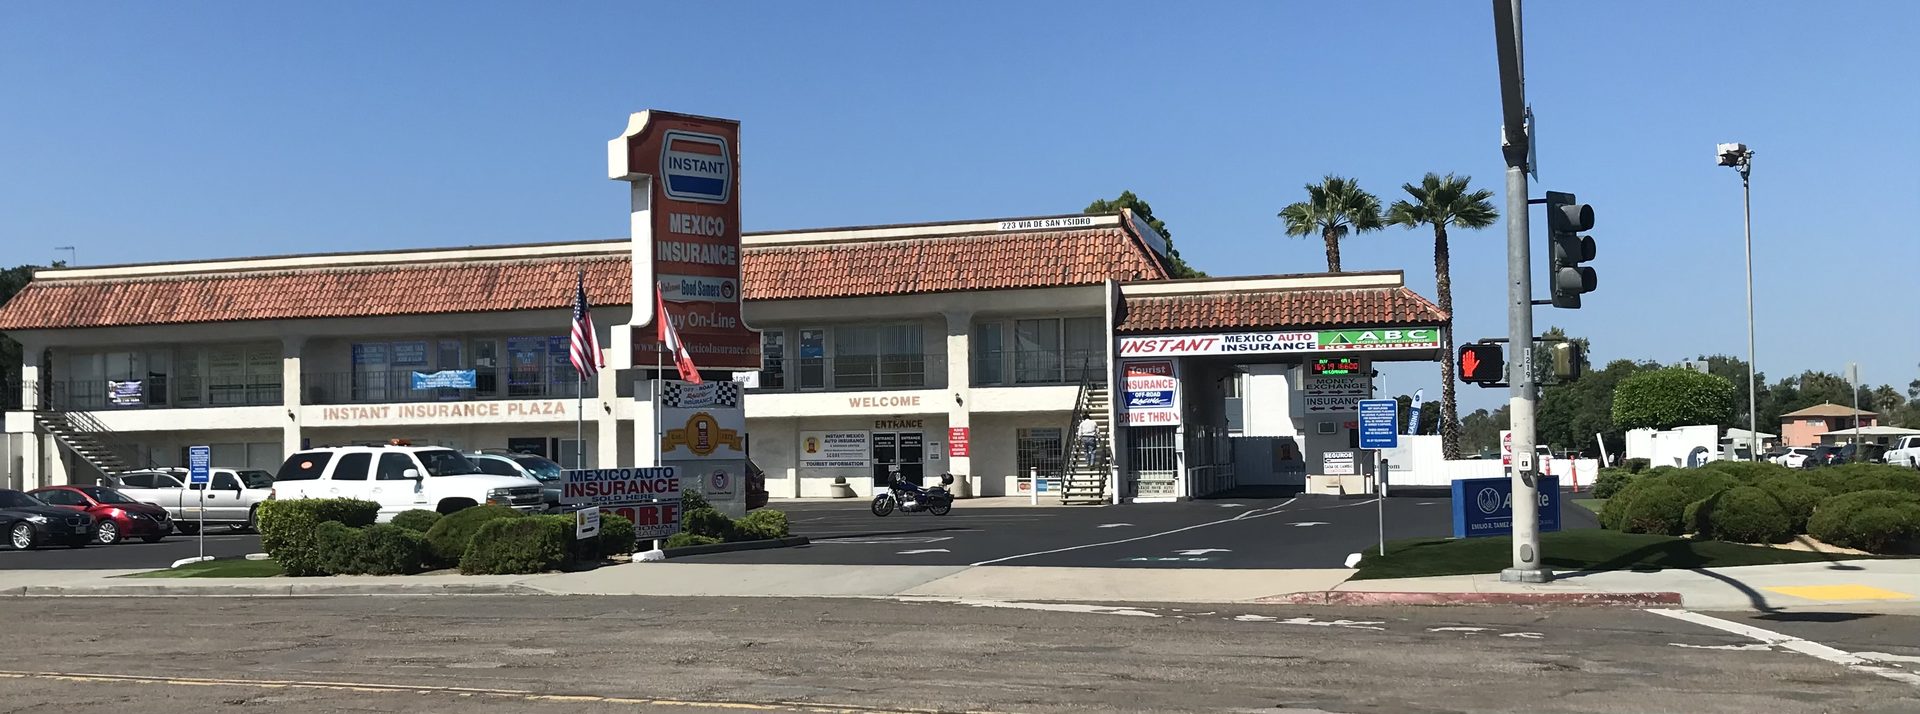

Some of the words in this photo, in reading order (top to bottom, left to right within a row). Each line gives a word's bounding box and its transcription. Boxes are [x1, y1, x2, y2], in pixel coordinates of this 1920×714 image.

[668, 156, 725, 174] INSTANT
[669, 213, 725, 237] MEXICO
[1045, 219, 1060, 227] SAN
[657, 240, 736, 266] INSURANCE
[669, 314, 685, 329] uy
[688, 312, 736, 329] On-Line
[1356, 329, 1430, 341] ABC
[1121, 338, 1220, 353] INSTANT
[1224, 334, 1274, 343] MEXICO
[1277, 333, 1312, 342] AUTO
[1221, 341, 1316, 352] INSURANCE
[1129, 366, 1166, 374] Tourist
[1122, 379, 1174, 390] INSURANCE
[849, 396, 921, 408] WELCOME
[1306, 397, 1359, 405] INSURANC
[323, 406, 390, 420] INSTANT
[399, 403, 499, 418] INSURANCE
[507, 401, 566, 416] PLAZA
[1119, 412, 1145, 423] DRIVE
[1147, 411, 1172, 422] THRU
[1408, 410, 1419, 434] EASING
[875, 419, 923, 429] ENTRANCE
[569, 468, 631, 482] MEXICO
[634, 467, 674, 480] AUTO
[564, 478, 679, 497] INSURANCE
[625, 493, 654, 501] HERE
[1493, 521, 1510, 529] TAMEZ
